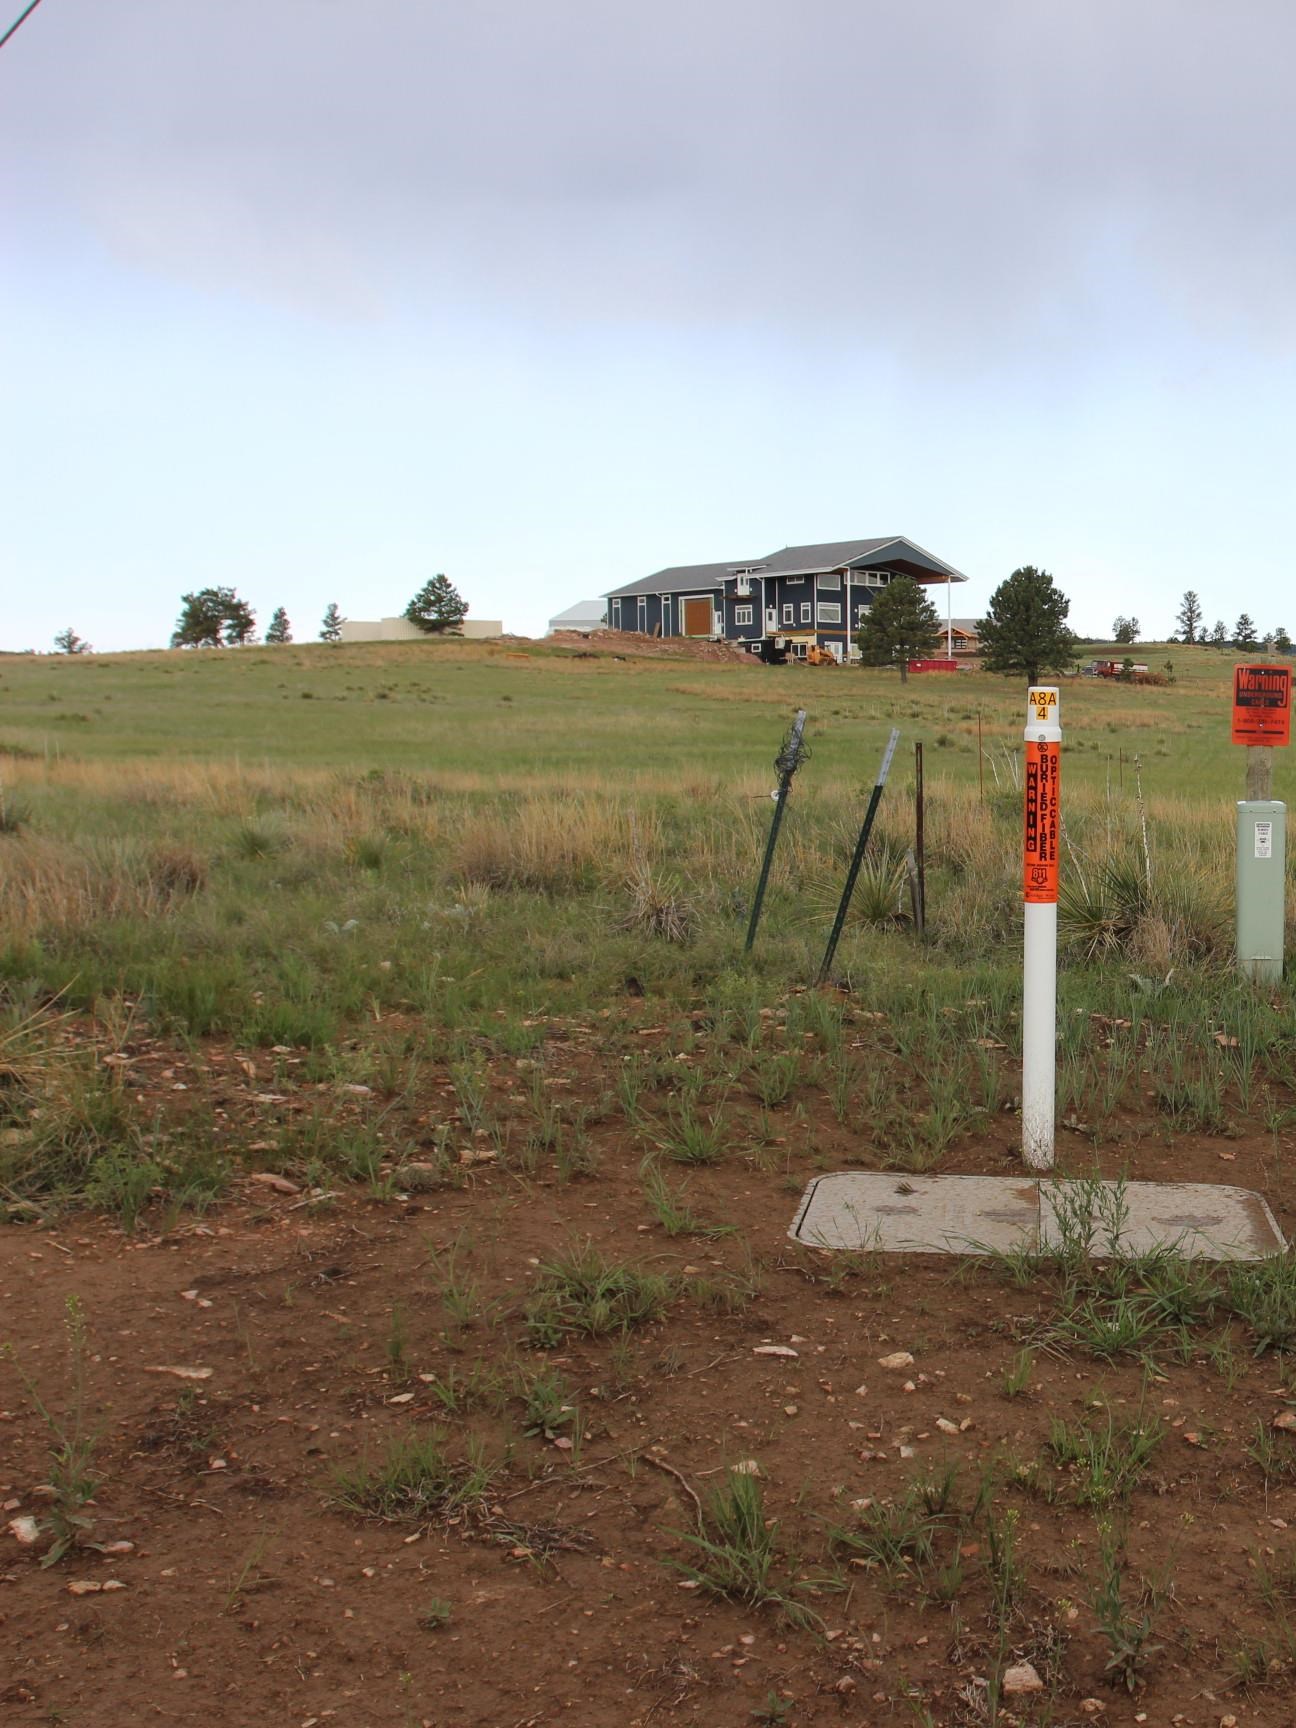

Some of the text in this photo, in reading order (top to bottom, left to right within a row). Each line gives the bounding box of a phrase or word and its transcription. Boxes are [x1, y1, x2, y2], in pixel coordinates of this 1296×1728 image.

[1029, 692, 1057, 706] A8A
[1238, 669, 1287, 706] Warning
[1037, 706, 1048, 720] 4
[1027, 764, 1037, 850] WARNING
[1040, 754, 1048, 861] BURIED FIBER
[1032, 868, 1047, 879] 811
